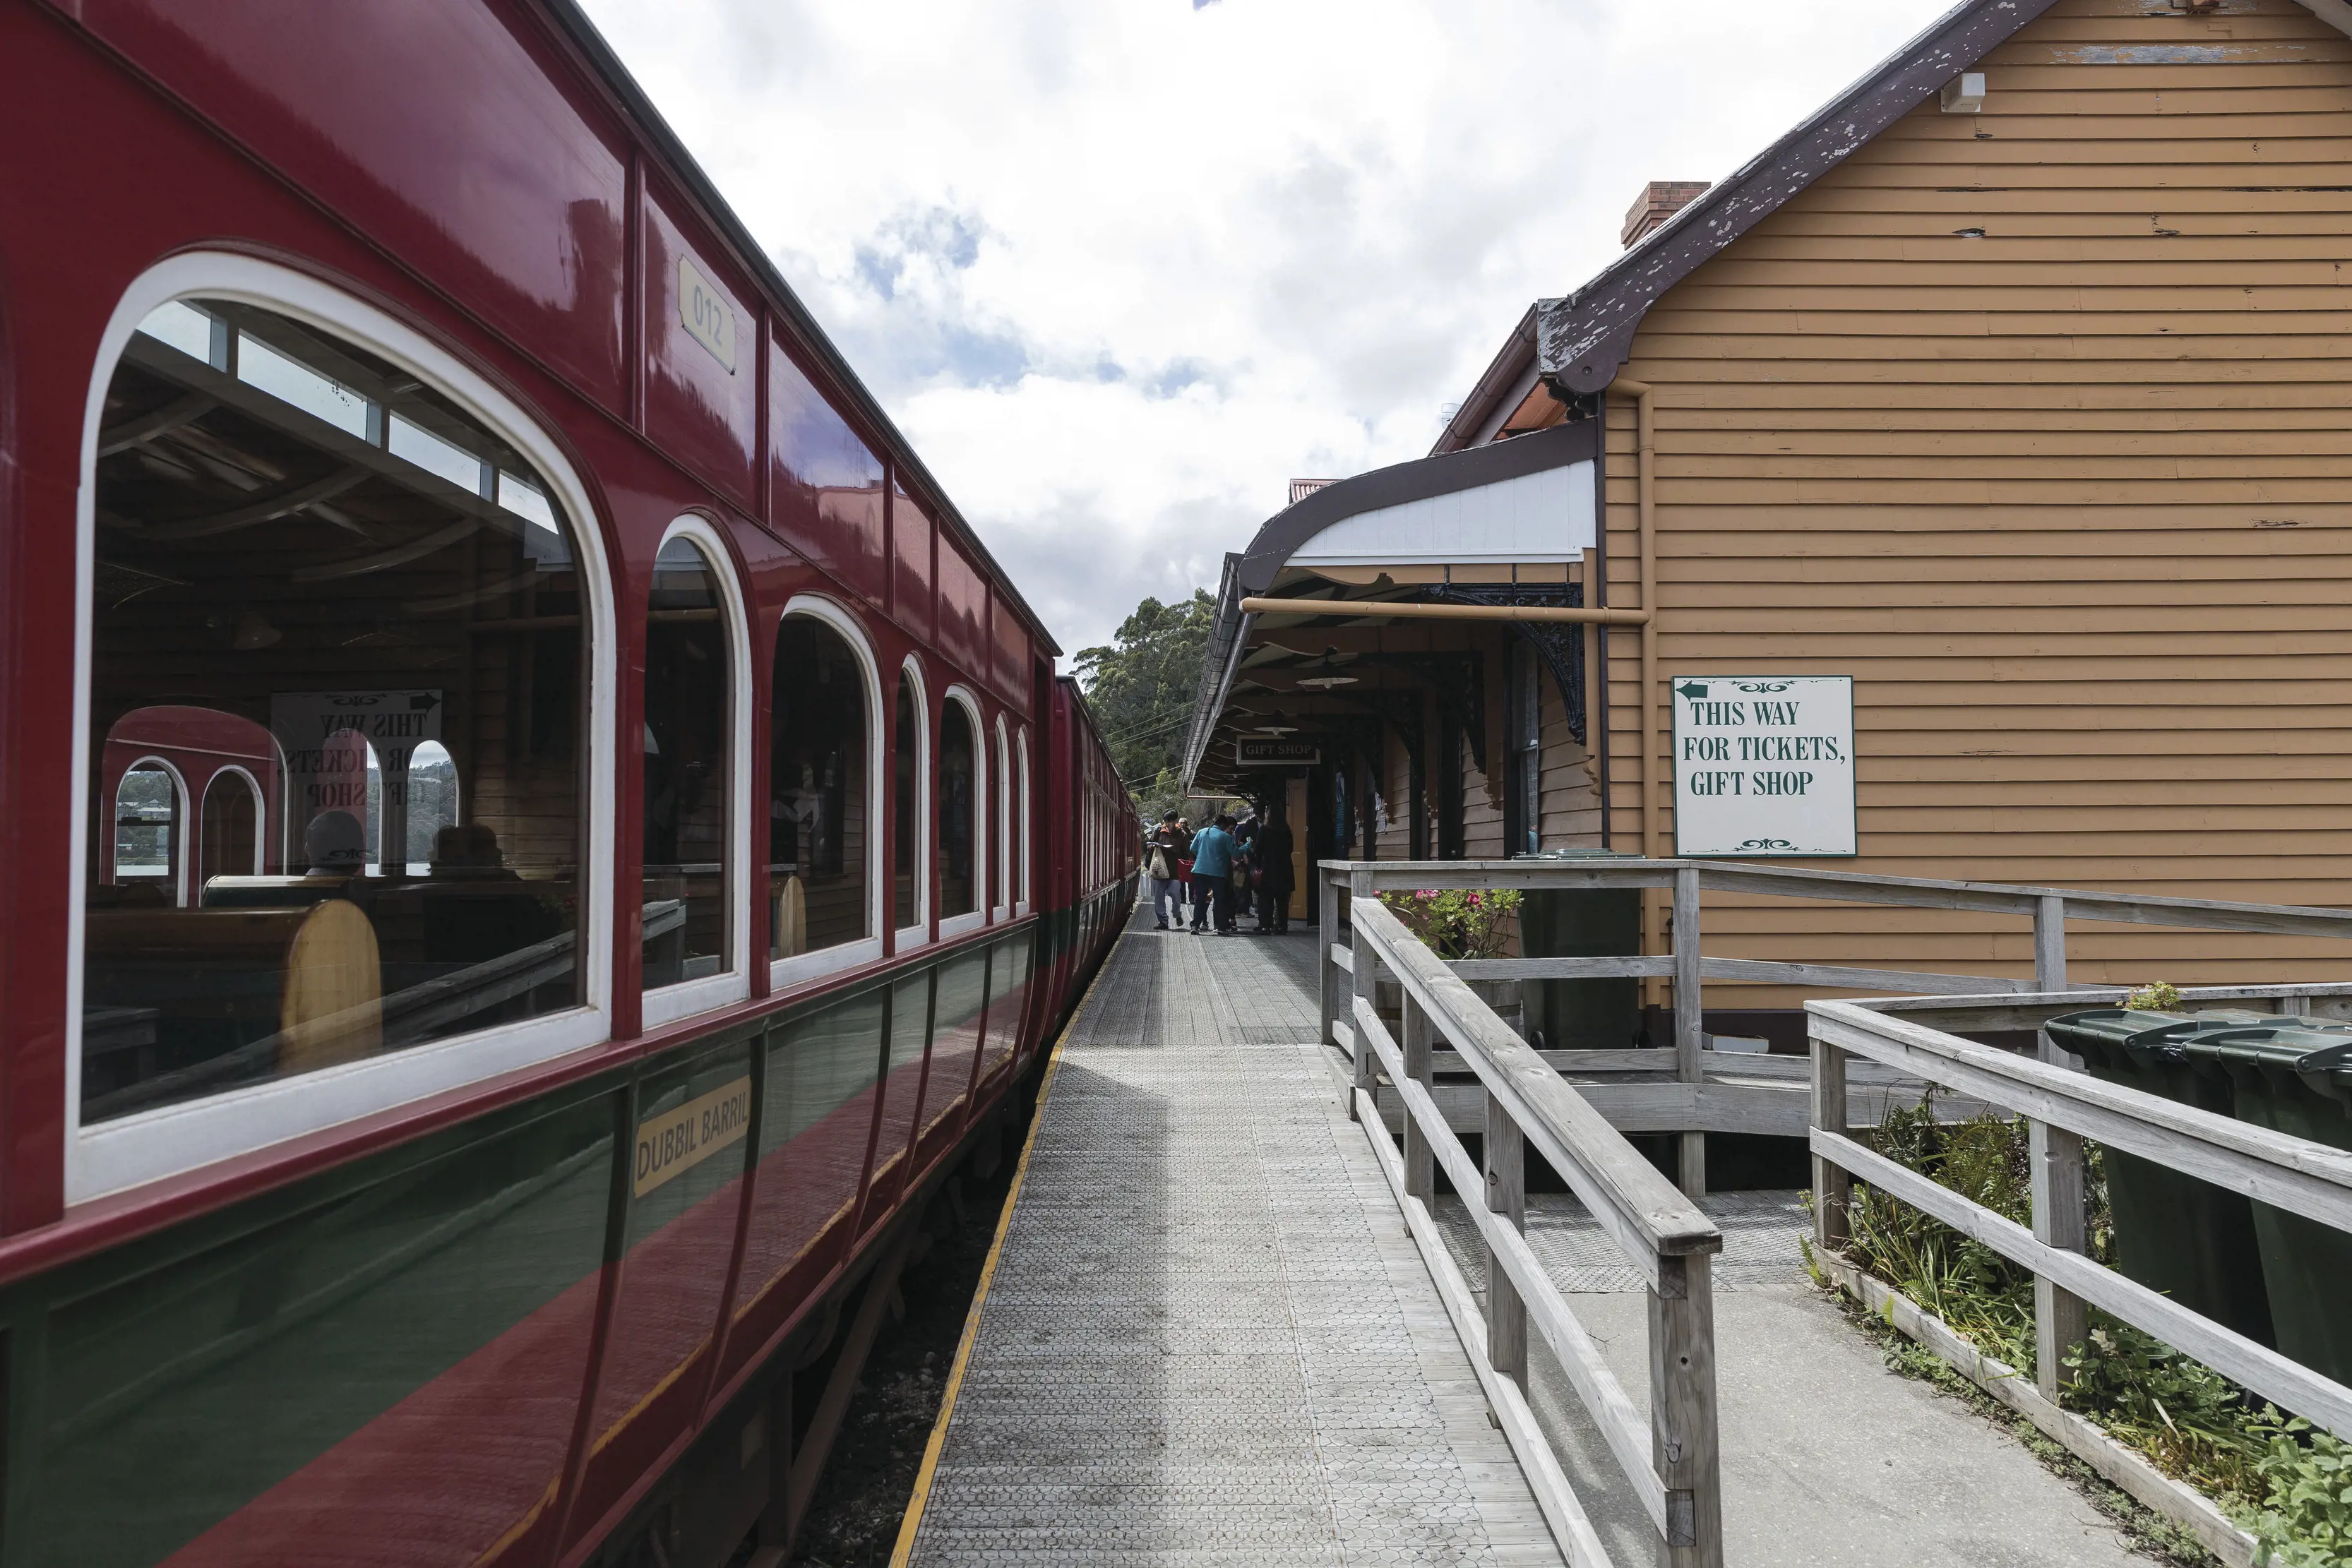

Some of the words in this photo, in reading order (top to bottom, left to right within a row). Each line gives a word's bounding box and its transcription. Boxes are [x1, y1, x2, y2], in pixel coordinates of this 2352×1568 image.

[694, 285, 722, 347] 012
[1690, 701, 1745, 725] THIS
[1753, 701, 1800, 725] WAY
[1246, 745, 1275, 755] GIFT
[1278, 744, 1312, 755] SHOP
[1683, 737, 1731, 760] FOR
[1738, 736, 1846, 765] TICKETS,
[1690, 771, 1745, 796] GIFT
[1753, 771, 1813, 796] SHOP
[637, 1117, 696, 1181] DUBBIL
[702, 1091, 748, 1145] BARRIL
